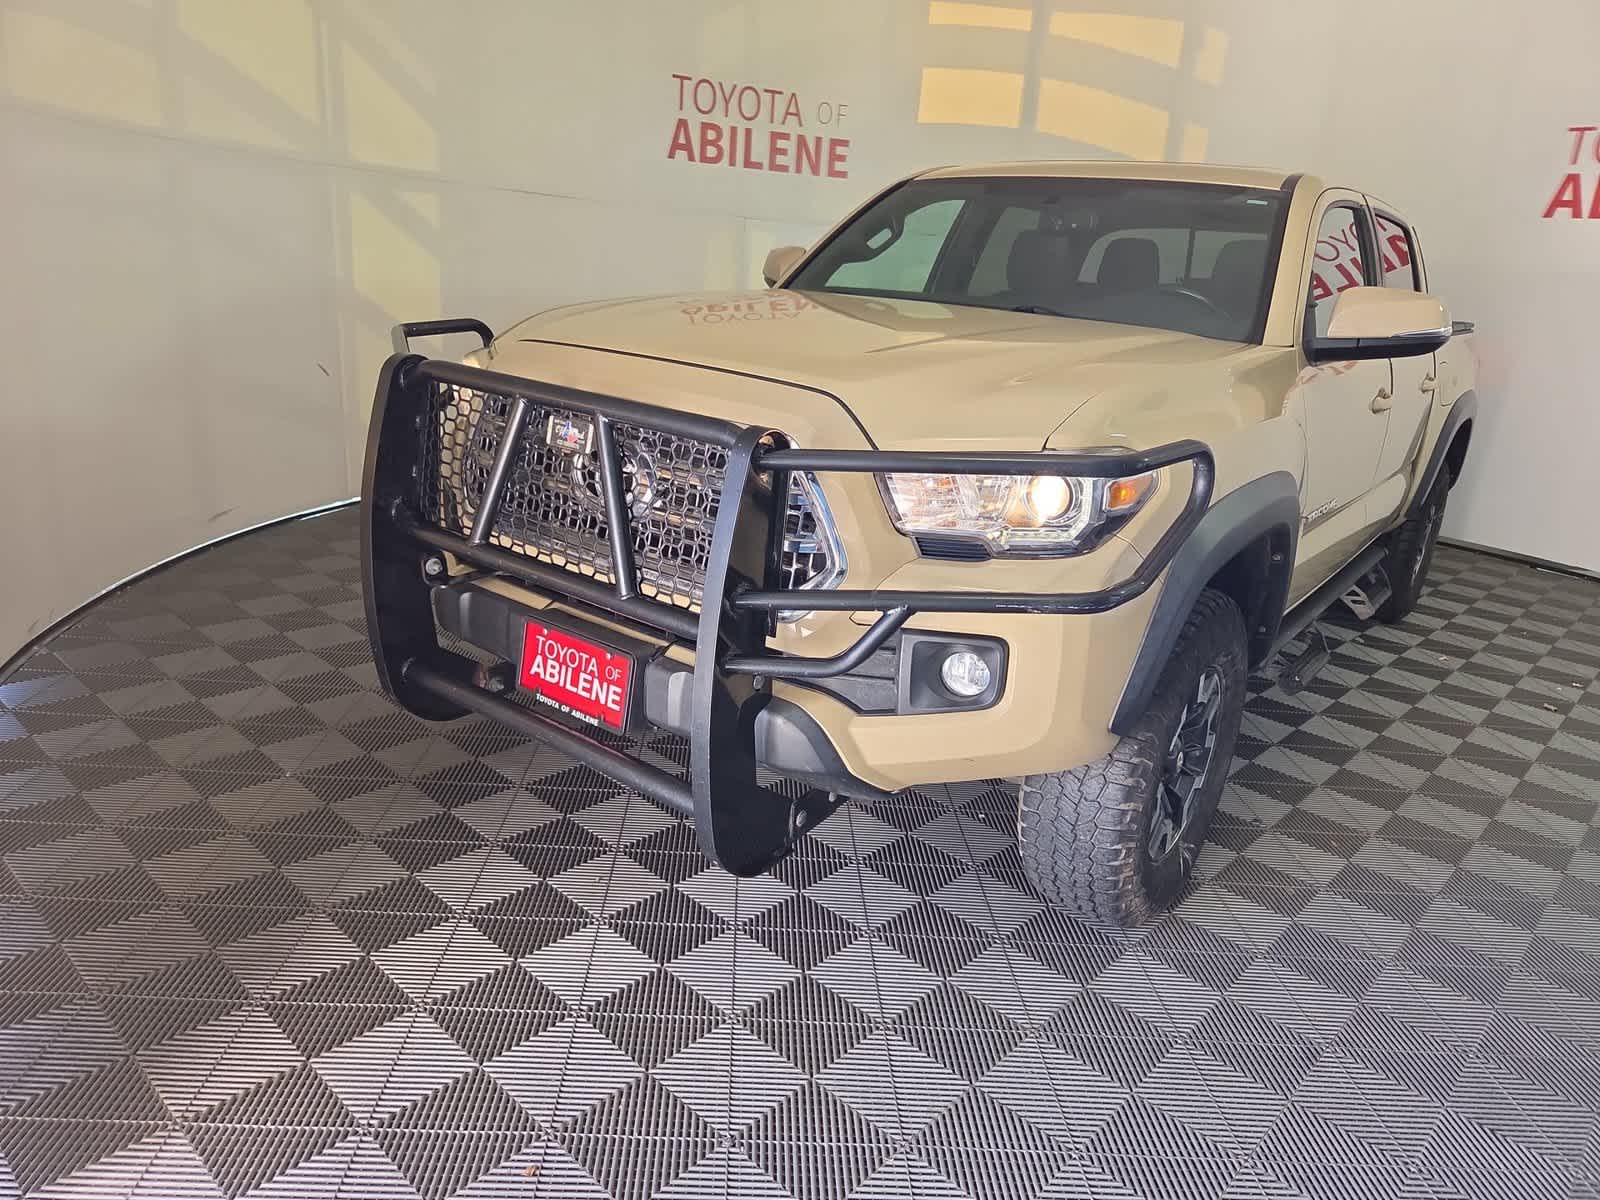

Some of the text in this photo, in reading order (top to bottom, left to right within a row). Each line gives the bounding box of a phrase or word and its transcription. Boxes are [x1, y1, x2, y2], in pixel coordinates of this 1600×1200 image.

[672, 73, 849, 128] TOYOTA OF
[667, 117, 850, 179] ABILENE
[530, 655, 623, 712] ABILENE
[535, 635, 623, 682] TOYOTA OF
[535, 693, 600, 727] TOYOTA OF ABILENE
